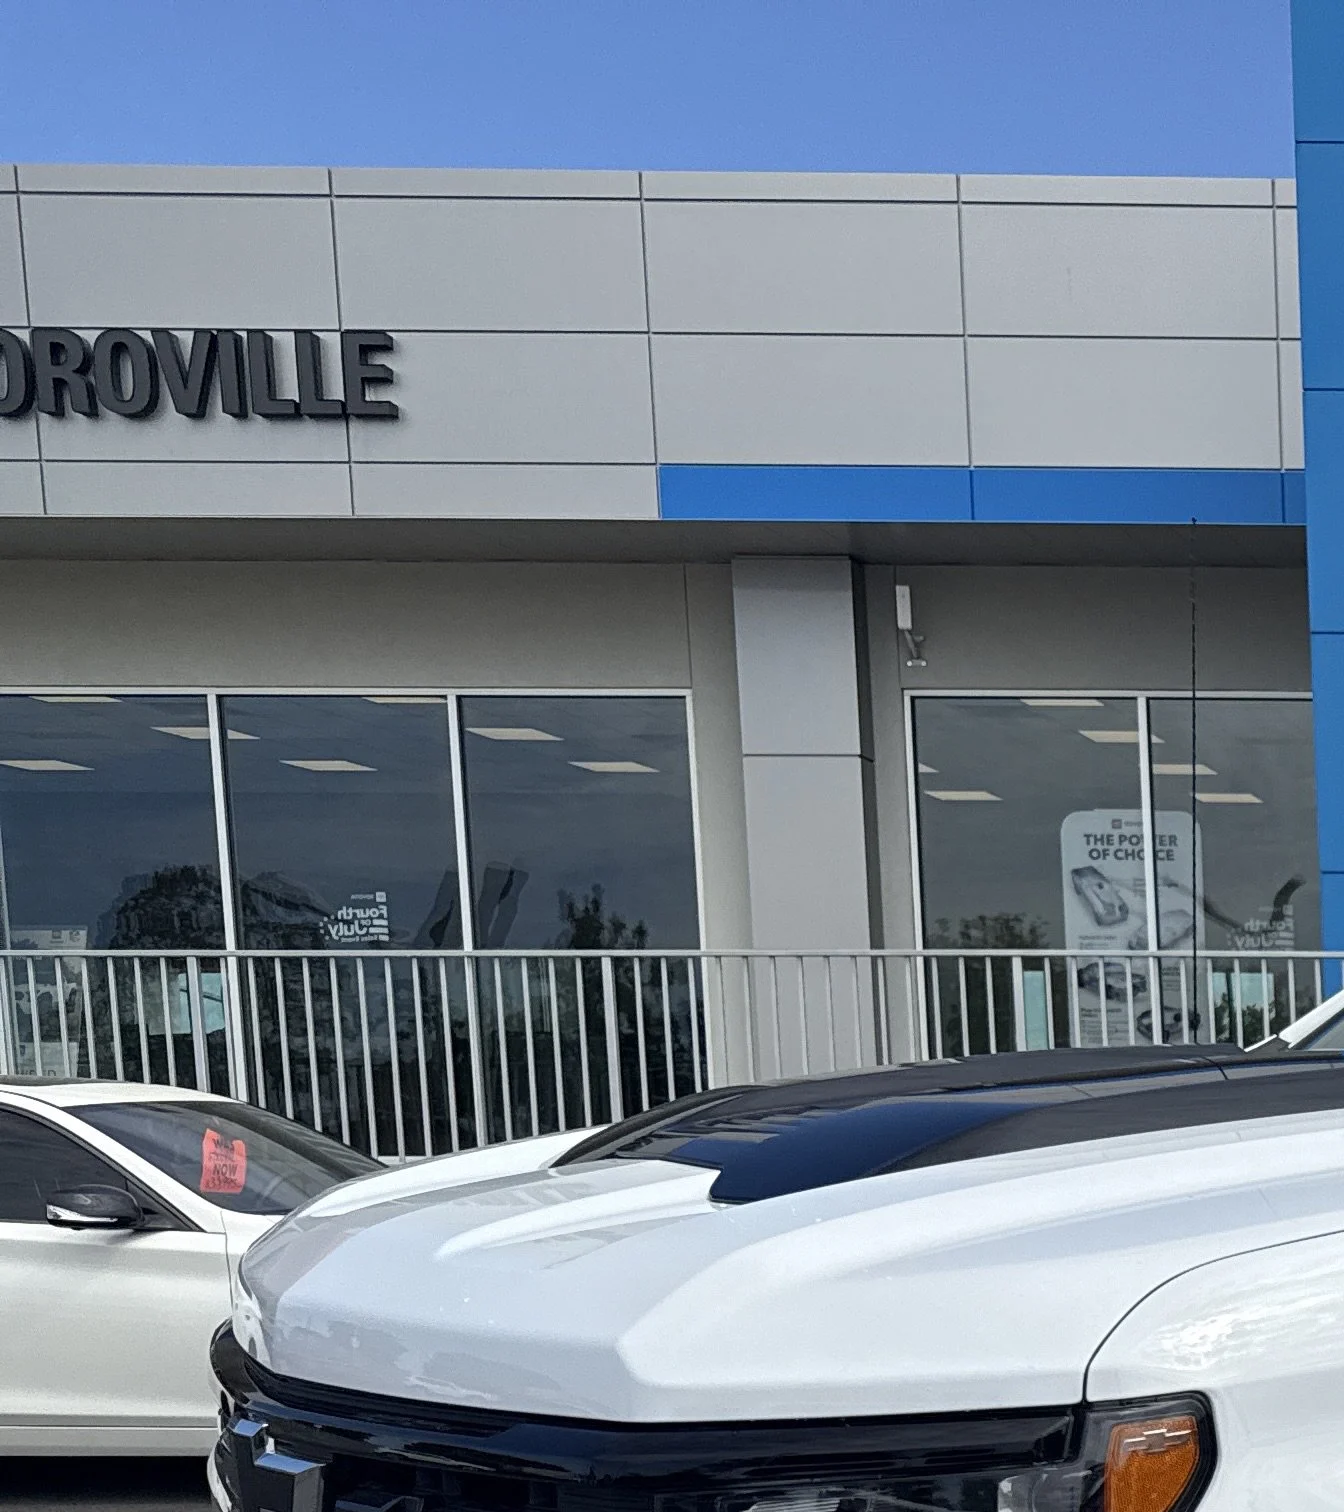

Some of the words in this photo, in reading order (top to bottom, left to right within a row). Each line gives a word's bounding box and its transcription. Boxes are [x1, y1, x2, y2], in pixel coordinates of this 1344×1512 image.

[1084, 834, 1115, 846] THE
[1118, 834, 1178, 847] POER
[1088, 848, 1110, 860] OF
[1113, 848, 1175, 861] CHOCE
[213, 1164, 238, 1177] NOW
